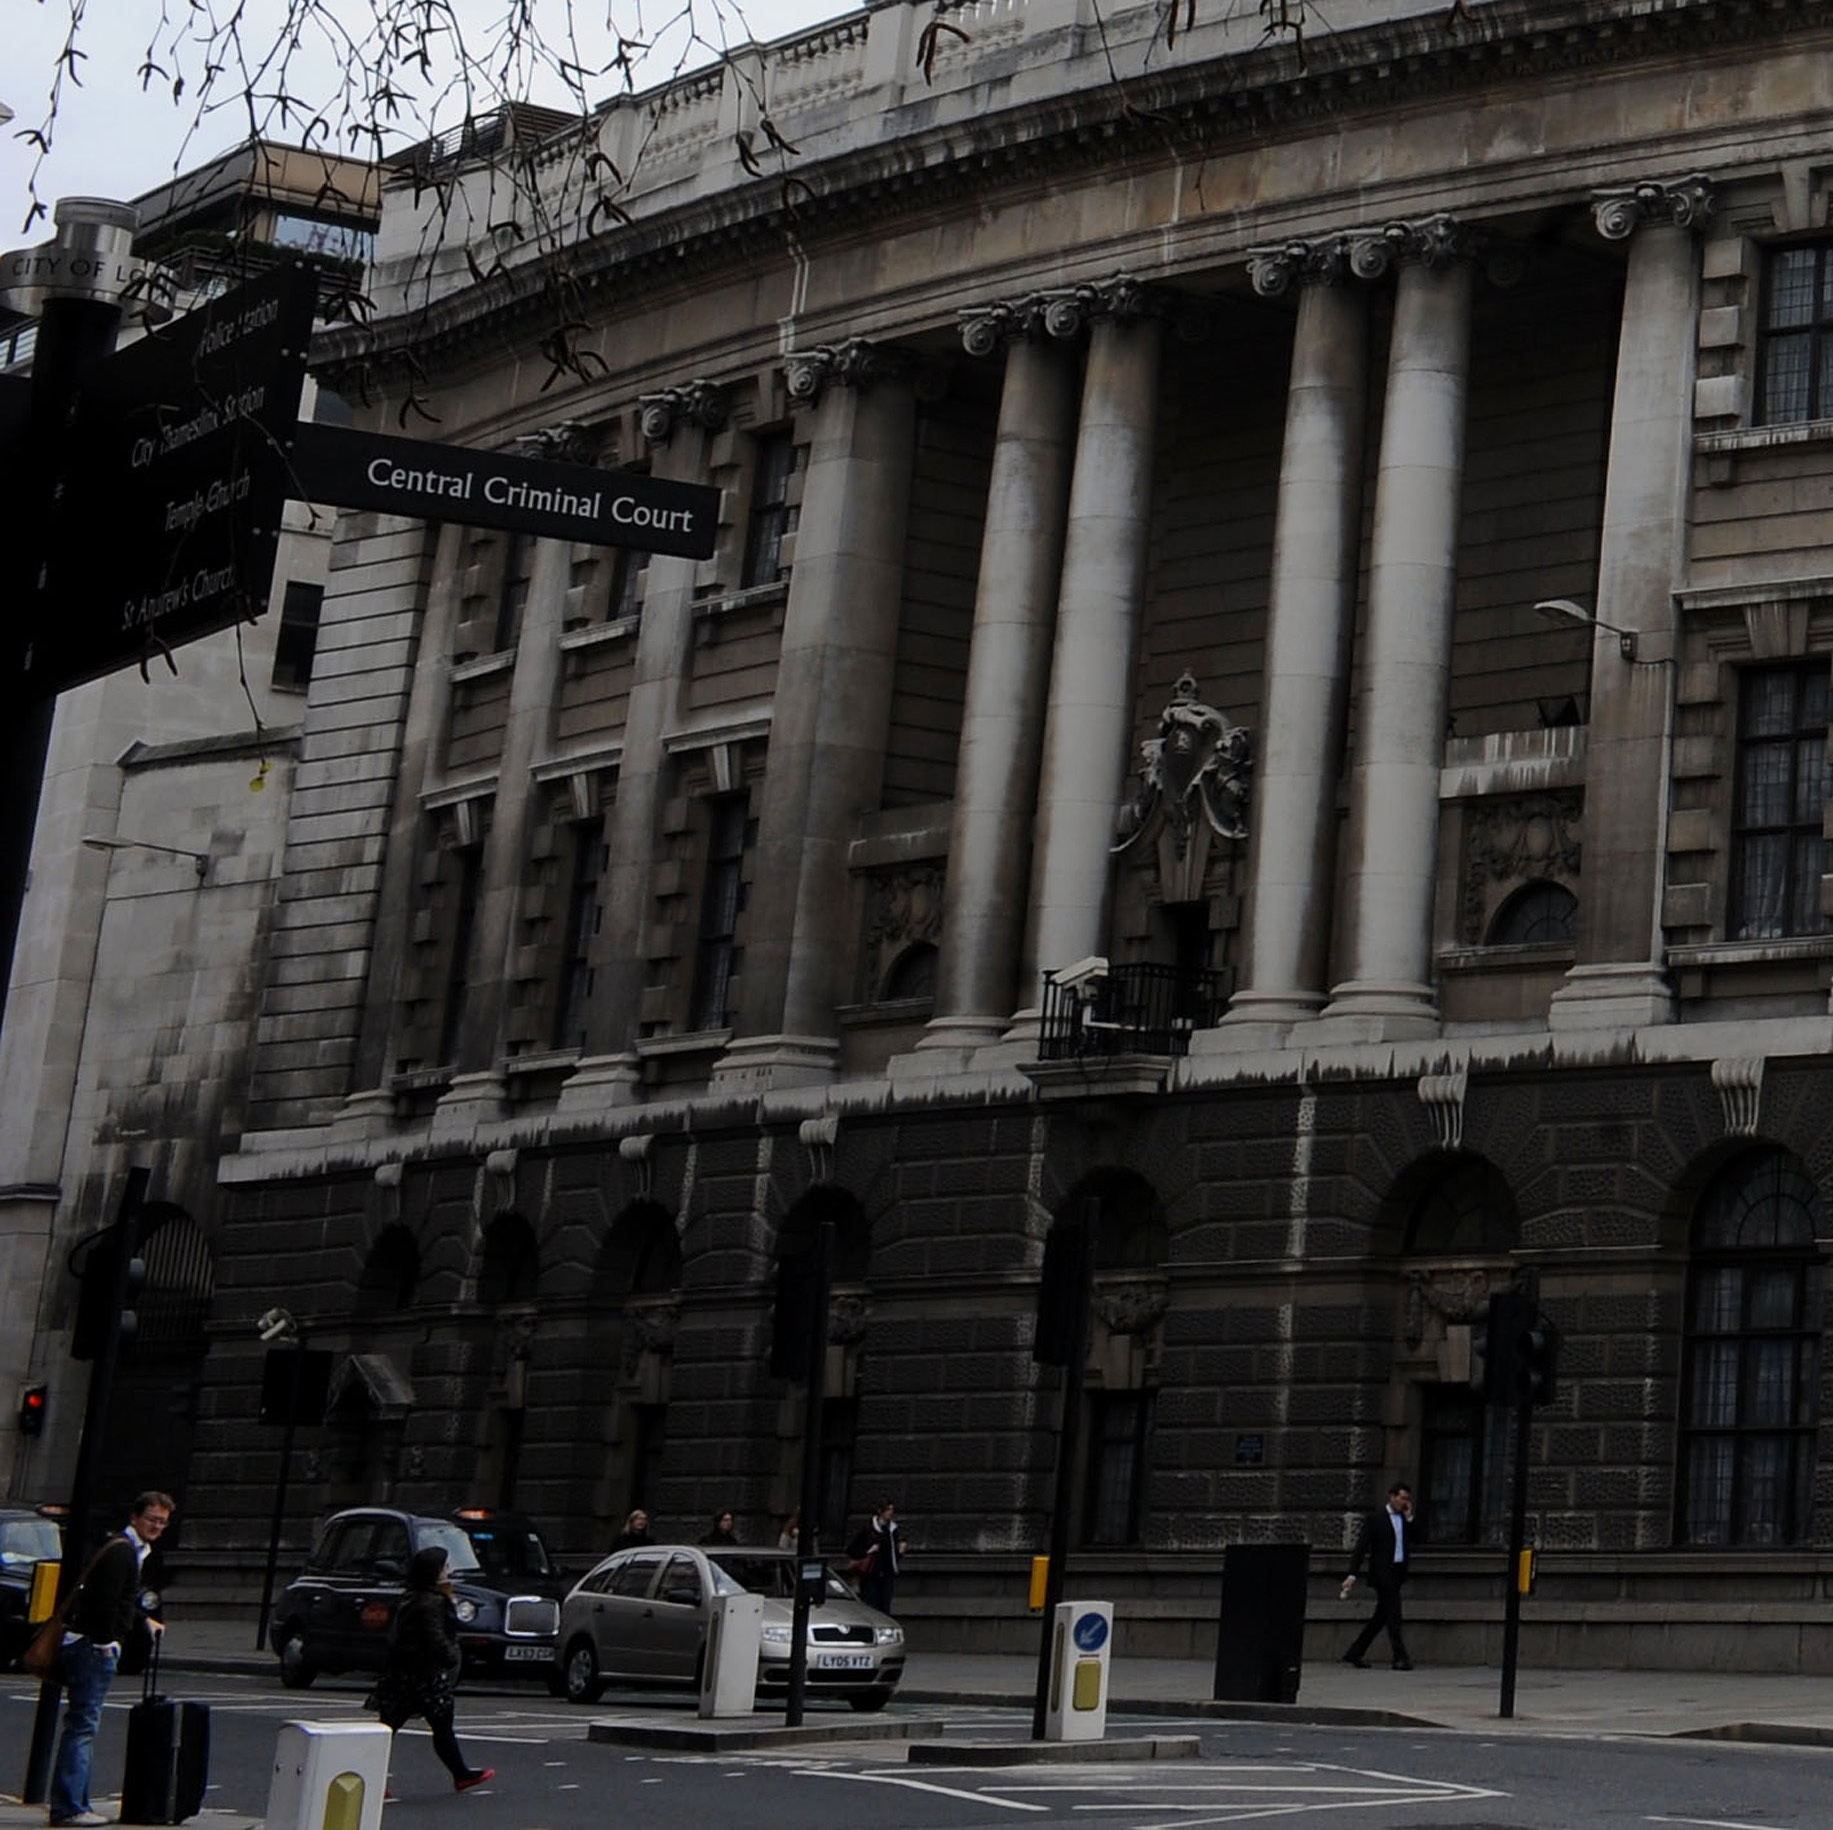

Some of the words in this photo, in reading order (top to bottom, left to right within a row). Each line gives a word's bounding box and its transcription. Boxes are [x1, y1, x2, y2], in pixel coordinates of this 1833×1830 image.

[12, 256, 61, 277] CITY
[70, 257, 105, 277] OF
[367, 458, 474, 500] Central
[484, 476, 601, 519] Criminal
[611, 496, 693, 533] Court
